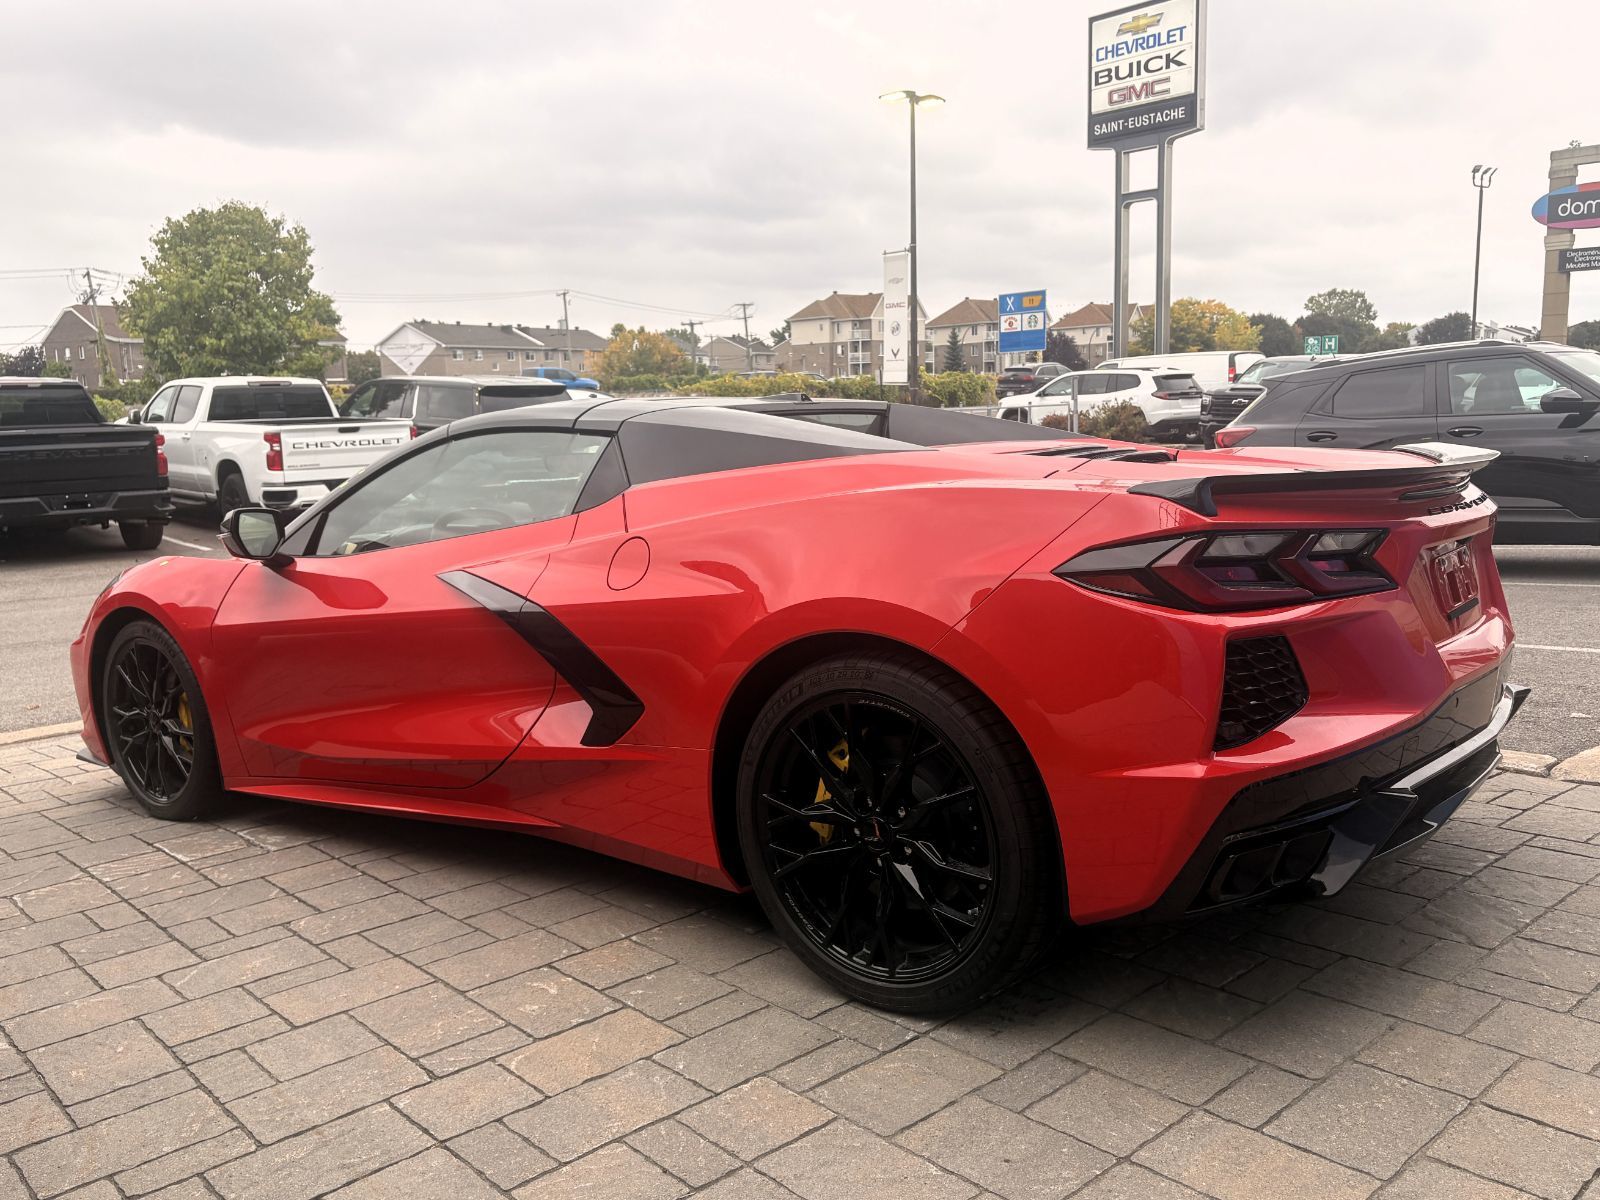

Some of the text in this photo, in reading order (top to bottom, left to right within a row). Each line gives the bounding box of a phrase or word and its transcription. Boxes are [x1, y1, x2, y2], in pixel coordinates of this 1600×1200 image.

[1096, 26, 1187, 63] CHEVROLET
[1094, 49, 1187, 87] BUICK
[1107, 76, 1171, 107] GMC
[1094, 107, 1186, 135] SAINT-EUSTACHE
[885, 302, 906, 310] GMC
[1324, 337, 1335, 350] H
[292, 437, 404, 450] CHEVROLET
